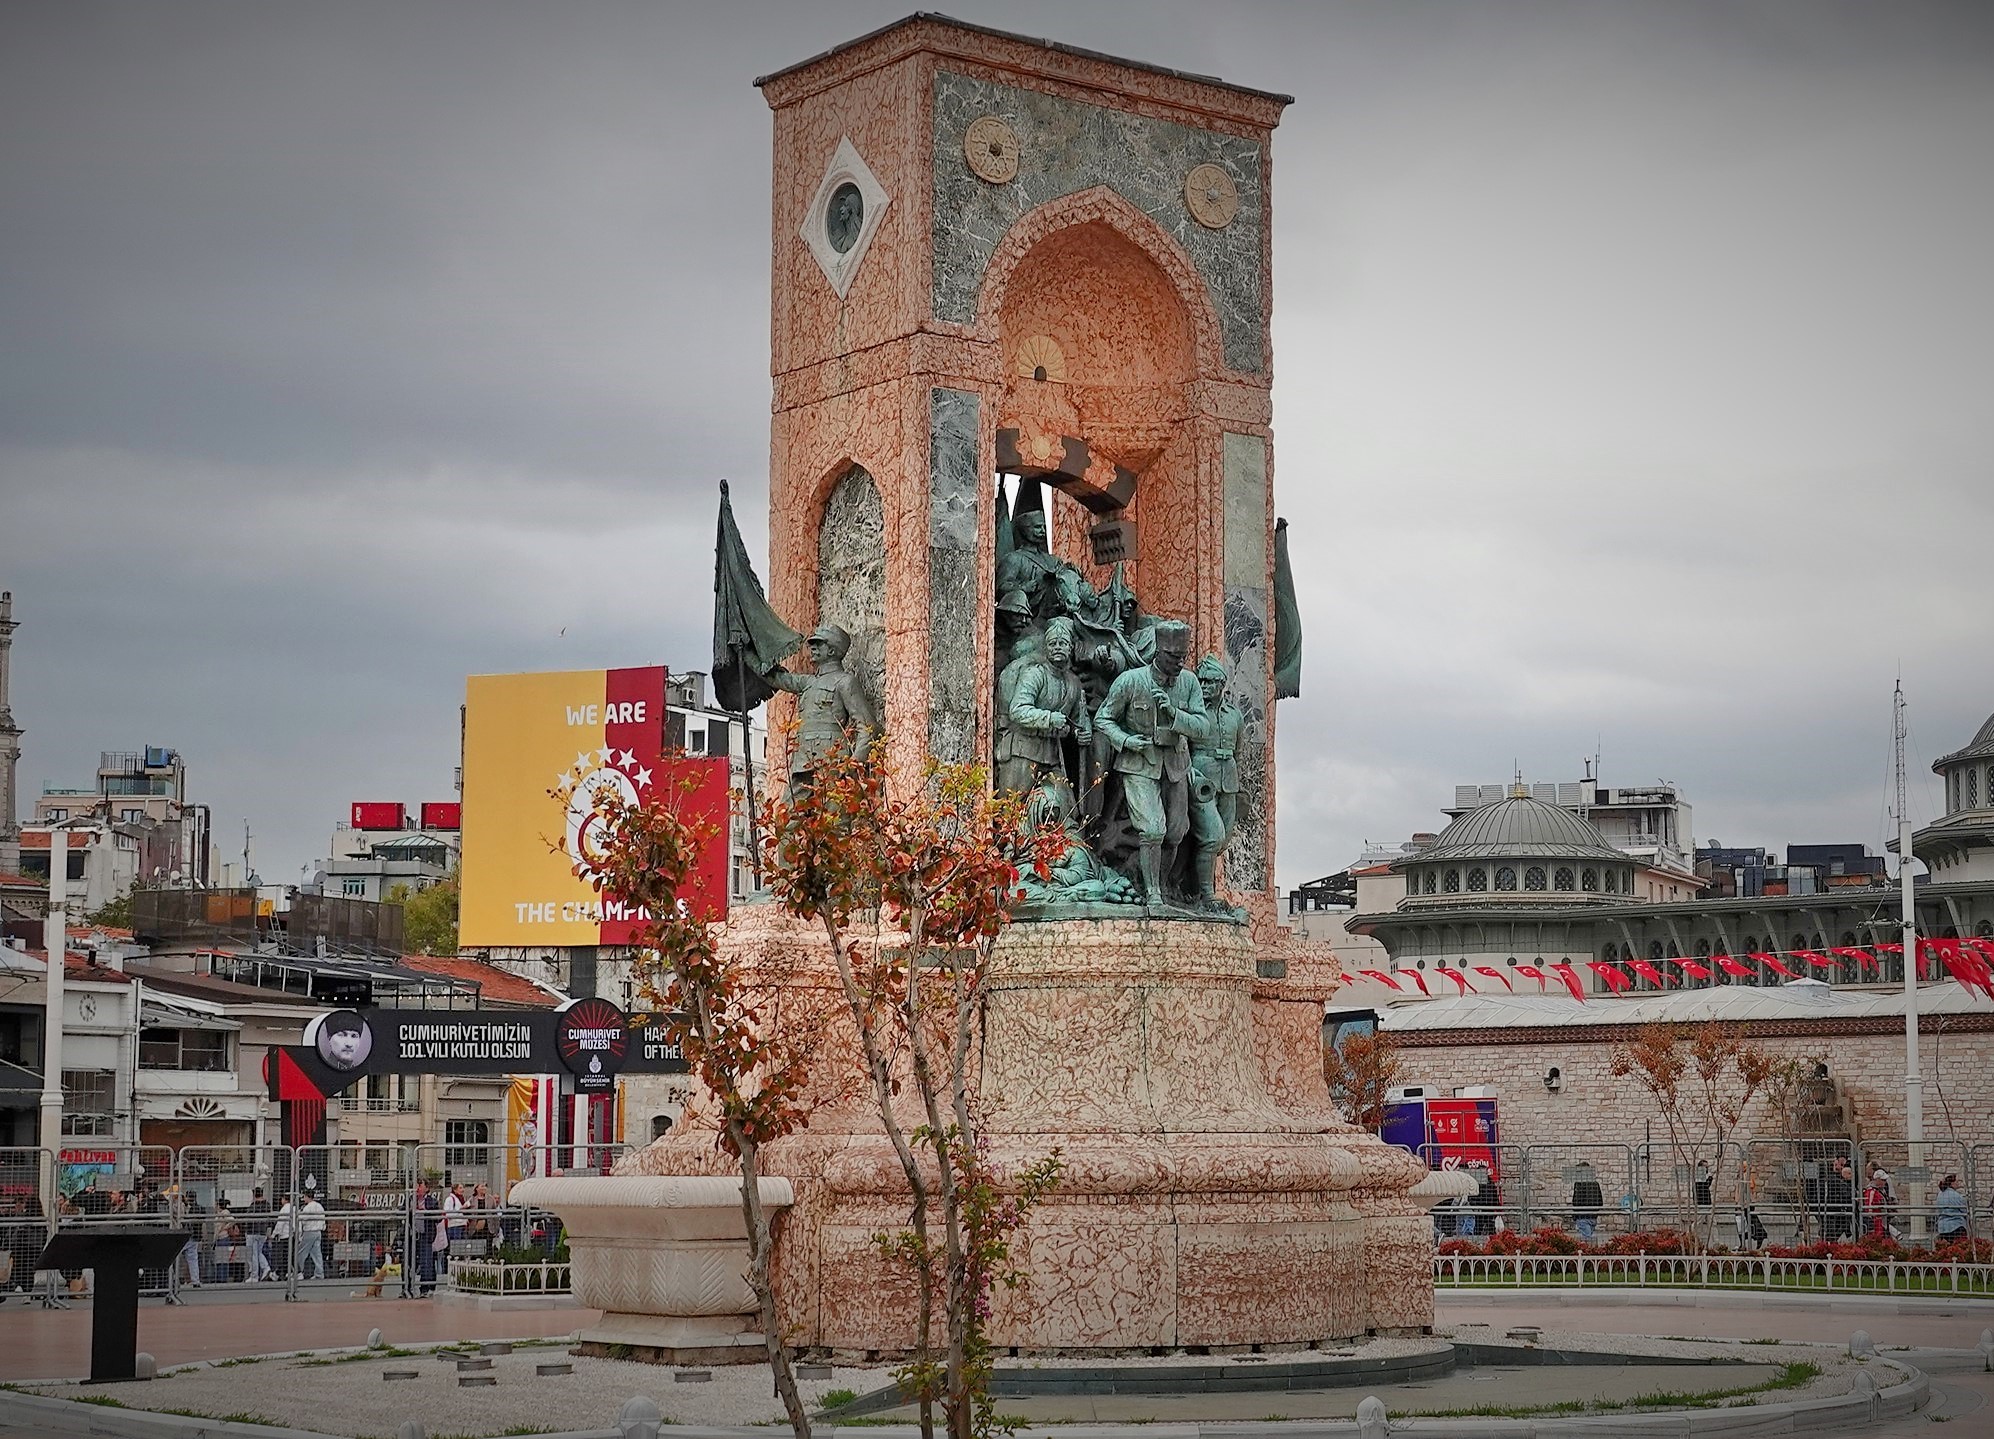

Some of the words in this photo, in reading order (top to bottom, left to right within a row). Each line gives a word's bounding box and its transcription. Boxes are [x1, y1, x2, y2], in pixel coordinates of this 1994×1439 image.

[566, 704, 598, 726] WE
[604, 701, 646, 724] ARE
[515, 901, 556, 924] THE
[399, 1022, 531, 1042] CUMHURİYETİMİZİN
[451, 1043, 490, 1059] KUTLU
[491, 1043, 531, 1059] OLSUN
[644, 1044, 658, 1060] OF
[658, 1044, 679, 1060] THE
[364, 1193, 396, 1208] KEBAP
